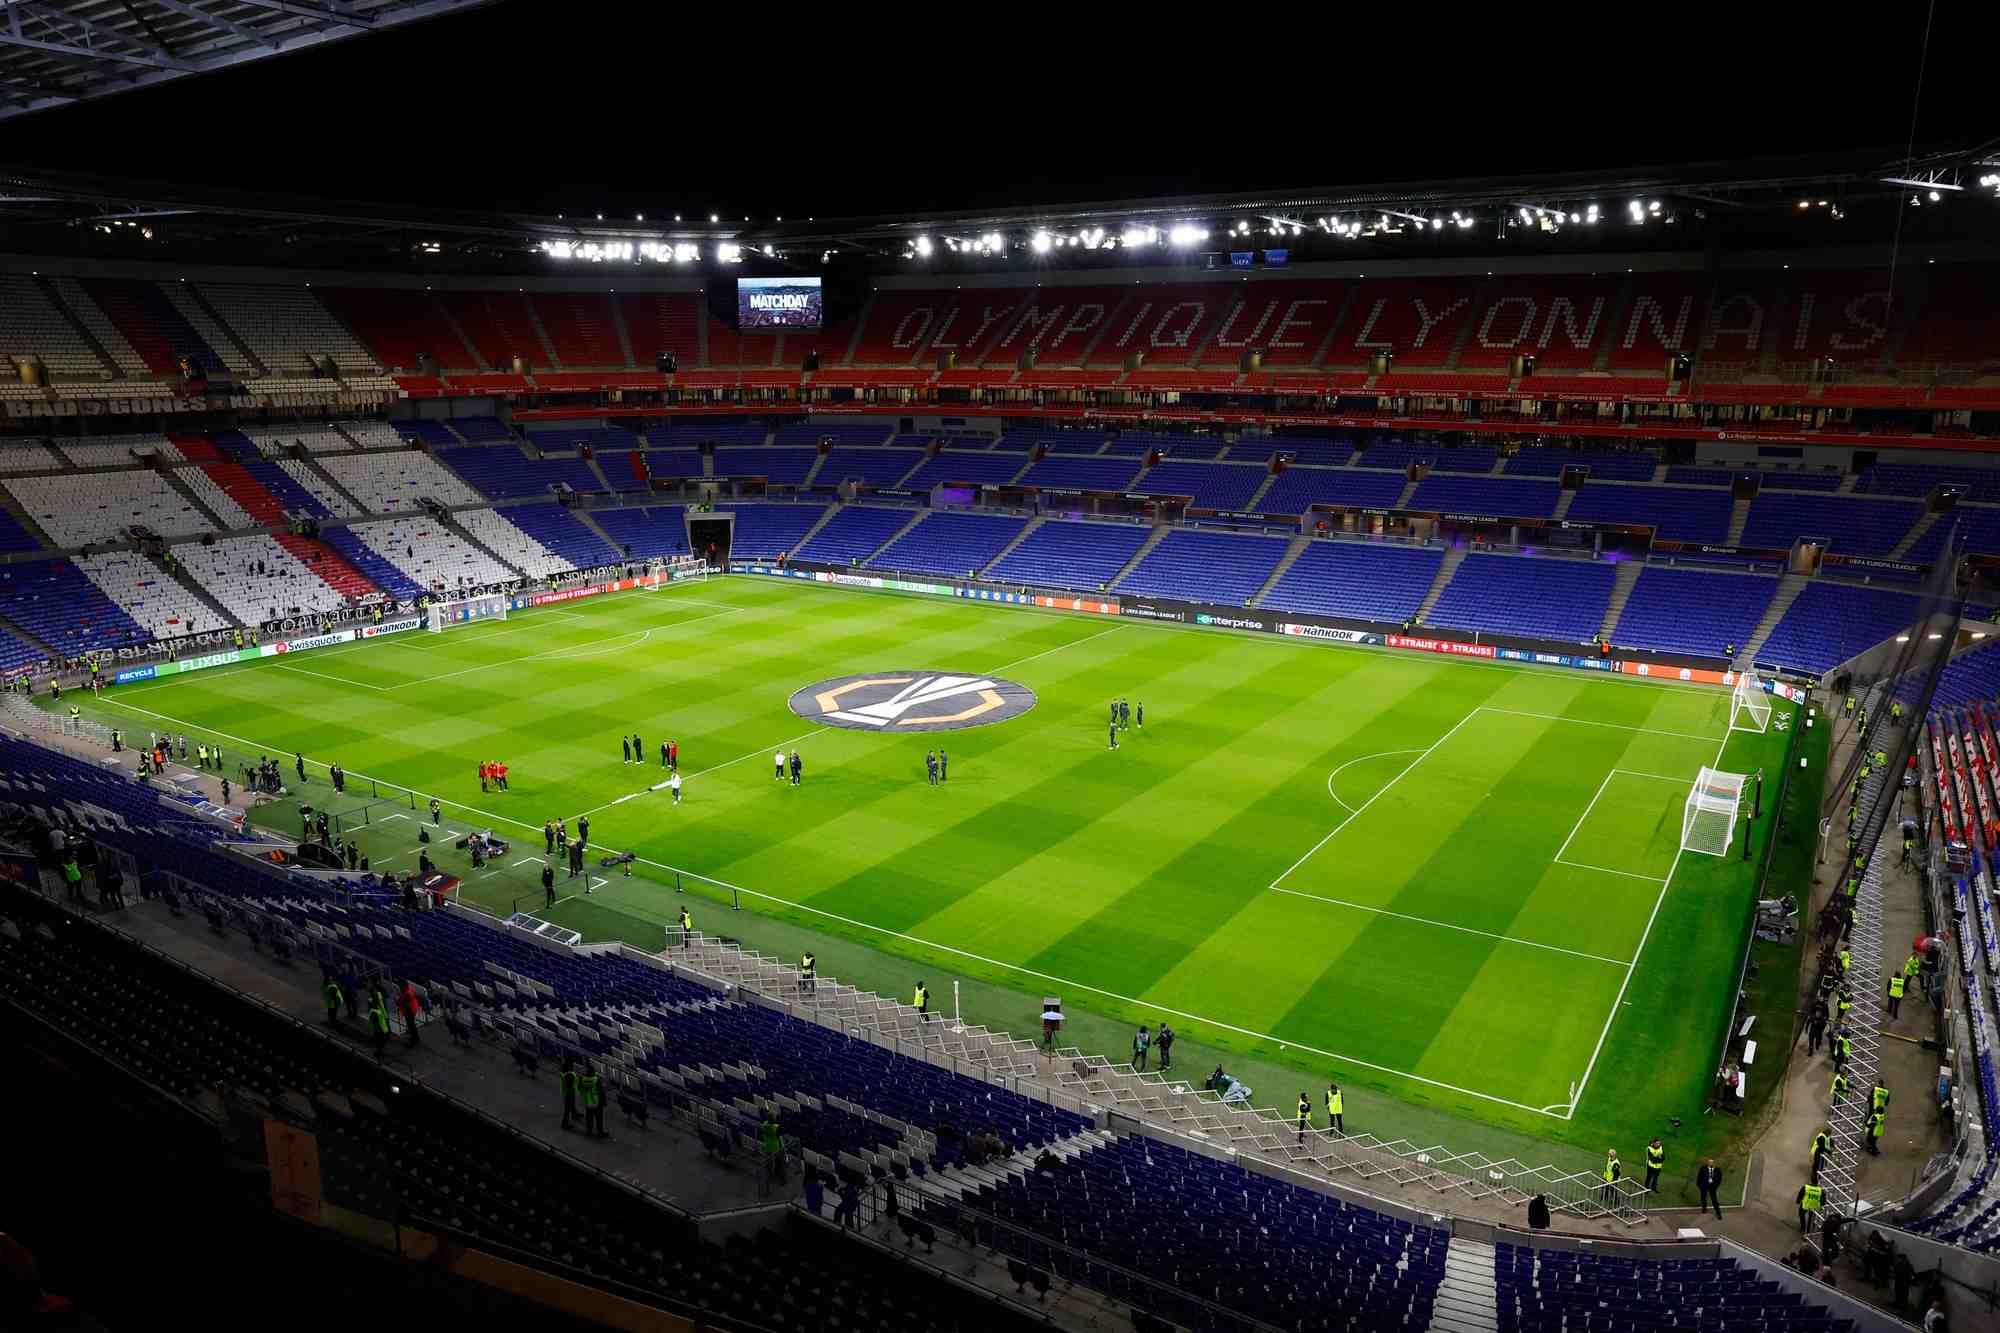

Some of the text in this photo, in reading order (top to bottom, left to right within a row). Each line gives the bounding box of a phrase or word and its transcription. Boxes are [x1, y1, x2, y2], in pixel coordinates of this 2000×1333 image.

[750, 294, 809, 308] MATCHDAY
[892, 294, 1890, 350] OLYMPIQUE LYONNAIS
[1201, 614, 1263, 629] enterprise
[288, 633, 343, 651] Swissquote
[1400, 638, 1491, 656] STRAUSS STRAUSS
[179, 650, 240, 672] FLIXBUS
[119, 668, 153, 681] RECYCLE
